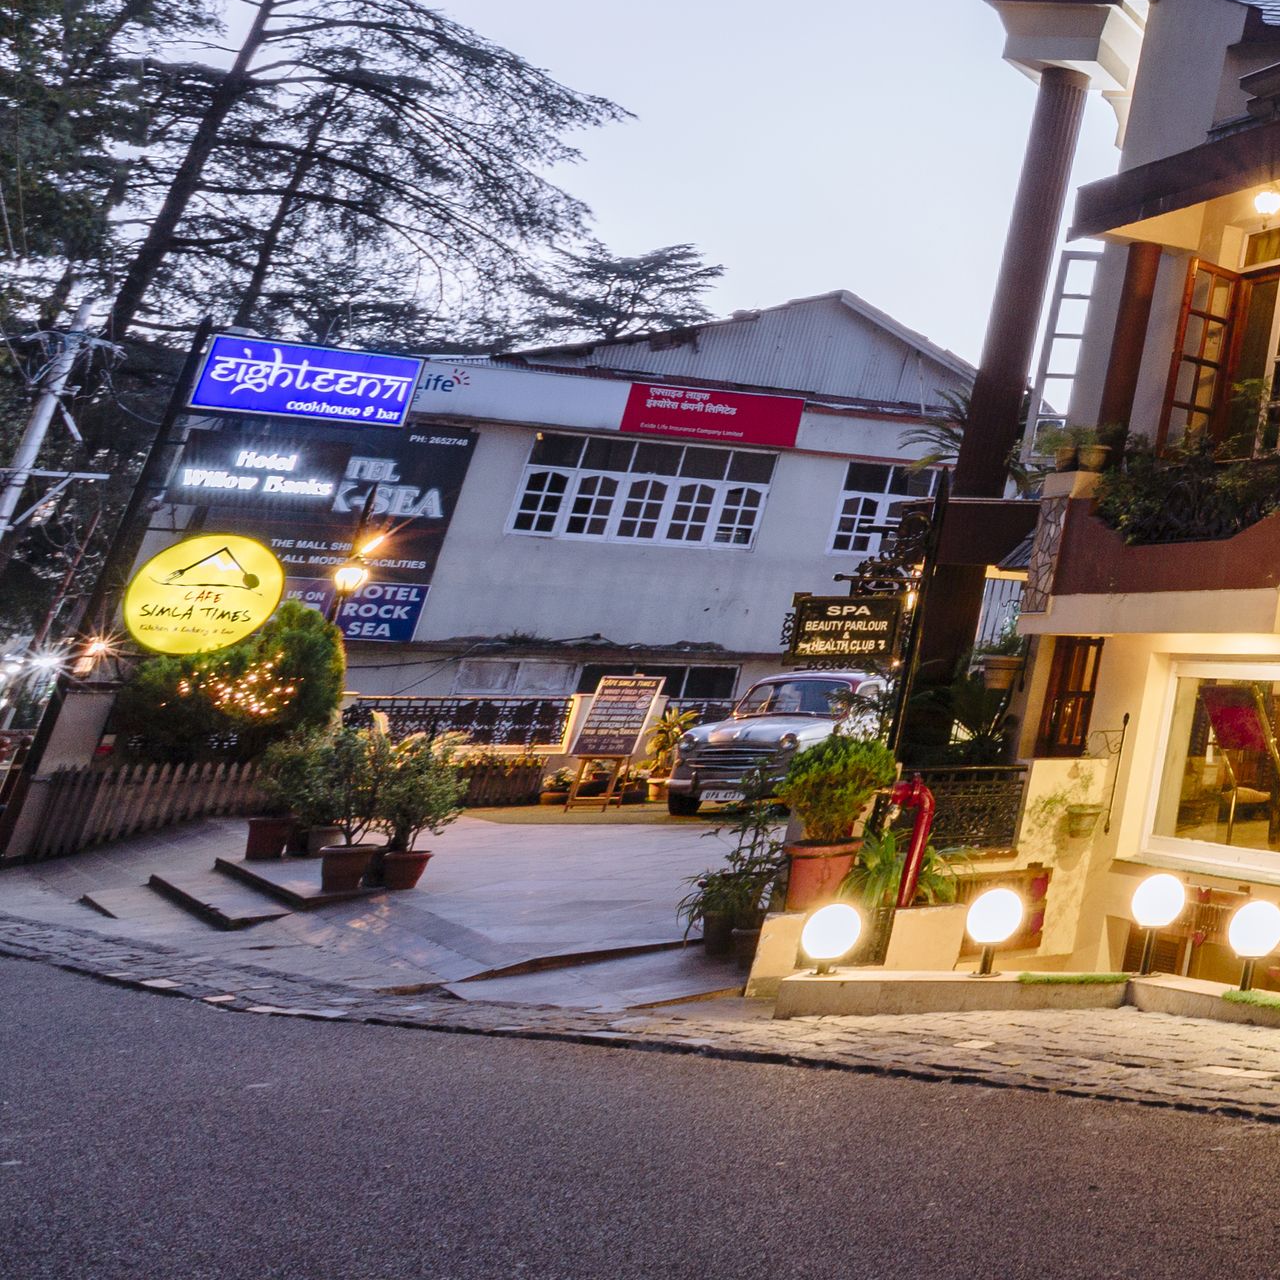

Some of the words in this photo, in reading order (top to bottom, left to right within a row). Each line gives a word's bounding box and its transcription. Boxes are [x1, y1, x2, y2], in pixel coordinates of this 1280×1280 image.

[286, 401, 361, 417] cookhouse
[376, 408, 401, 420] bar
[669, 425, 696, 433] Insurance
[696, 427, 722, 436] Company
[409, 434, 427, 443] PH:
[236, 451, 297, 471] Hotel
[347, 456, 401, 482] TEL
[263, 476, 333, 495] Banks
[271, 538, 295, 548] THE
[296, 540, 328, 550] MALL
[331, 541, 353, 551] SHI
[282, 554, 305, 563] ALL
[309, 556, 347, 566] MODE
[184, 590, 224, 603] CAFE
[306, 591, 326, 601] ON
[139, 604, 194, 620] SIMLA
[200, 607, 252, 622] TIMES
[341, 603, 412, 619] ROCK
[827, 605, 871, 616] SPA
[346, 622, 391, 637] SEA
[805, 621, 843, 631] BEAUTY
[844, 621, 888, 631] PARLOUR
[842, 631, 850, 639] &
[811, 640, 850, 651] HEALTH
[850, 640, 875, 651] CLUB
